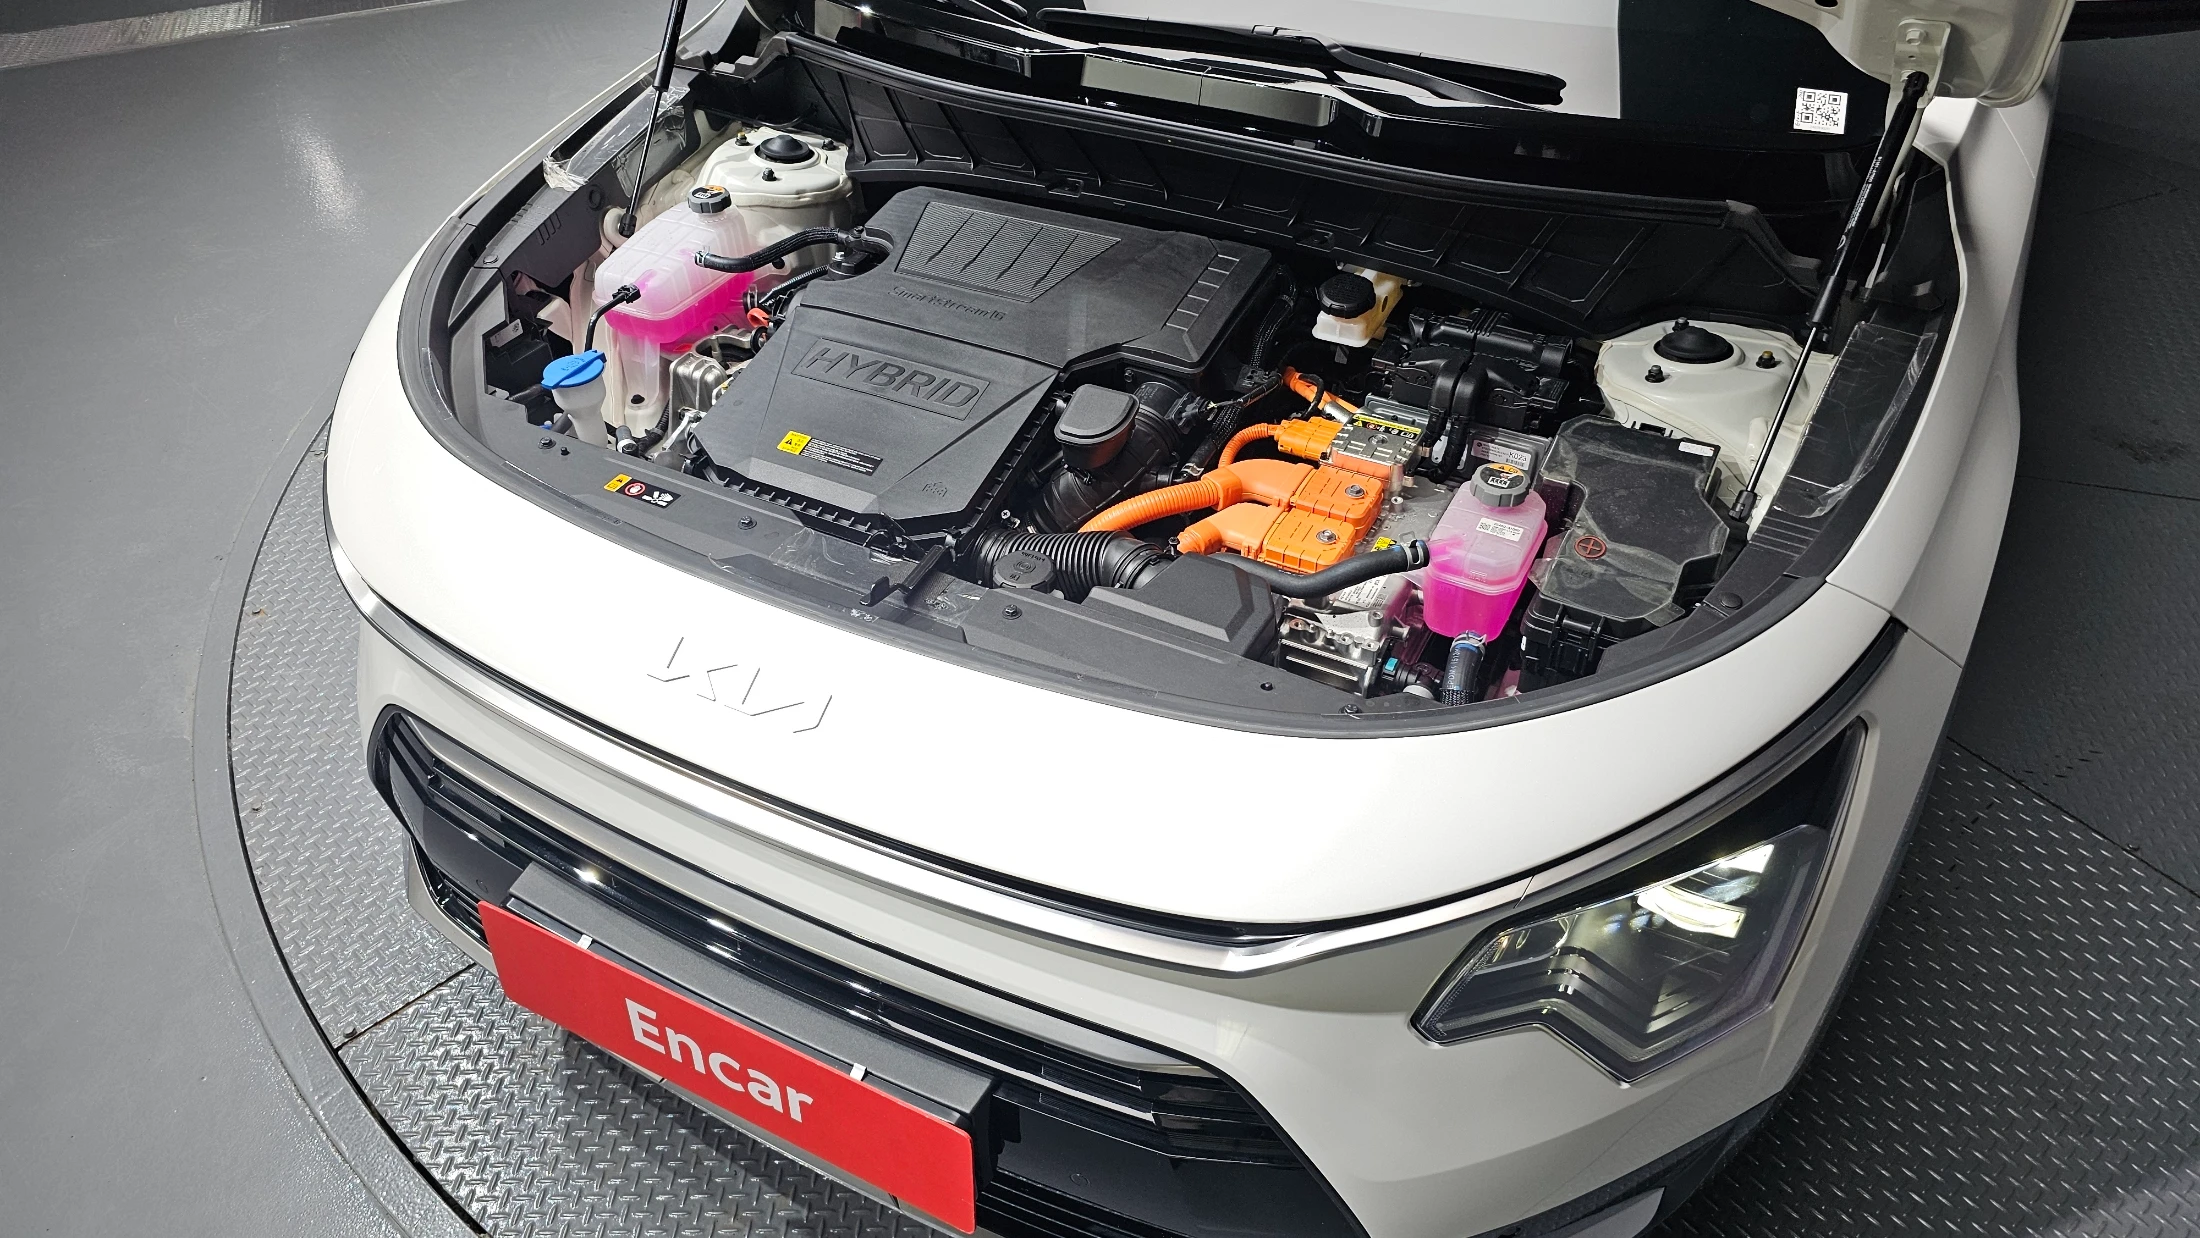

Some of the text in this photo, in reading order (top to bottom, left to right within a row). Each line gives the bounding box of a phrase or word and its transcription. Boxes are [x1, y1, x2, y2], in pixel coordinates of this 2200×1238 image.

[802, 347, 980, 408] HYBRID
[646, 636, 833, 734] KIA
[625, 998, 814, 1123] Encar
